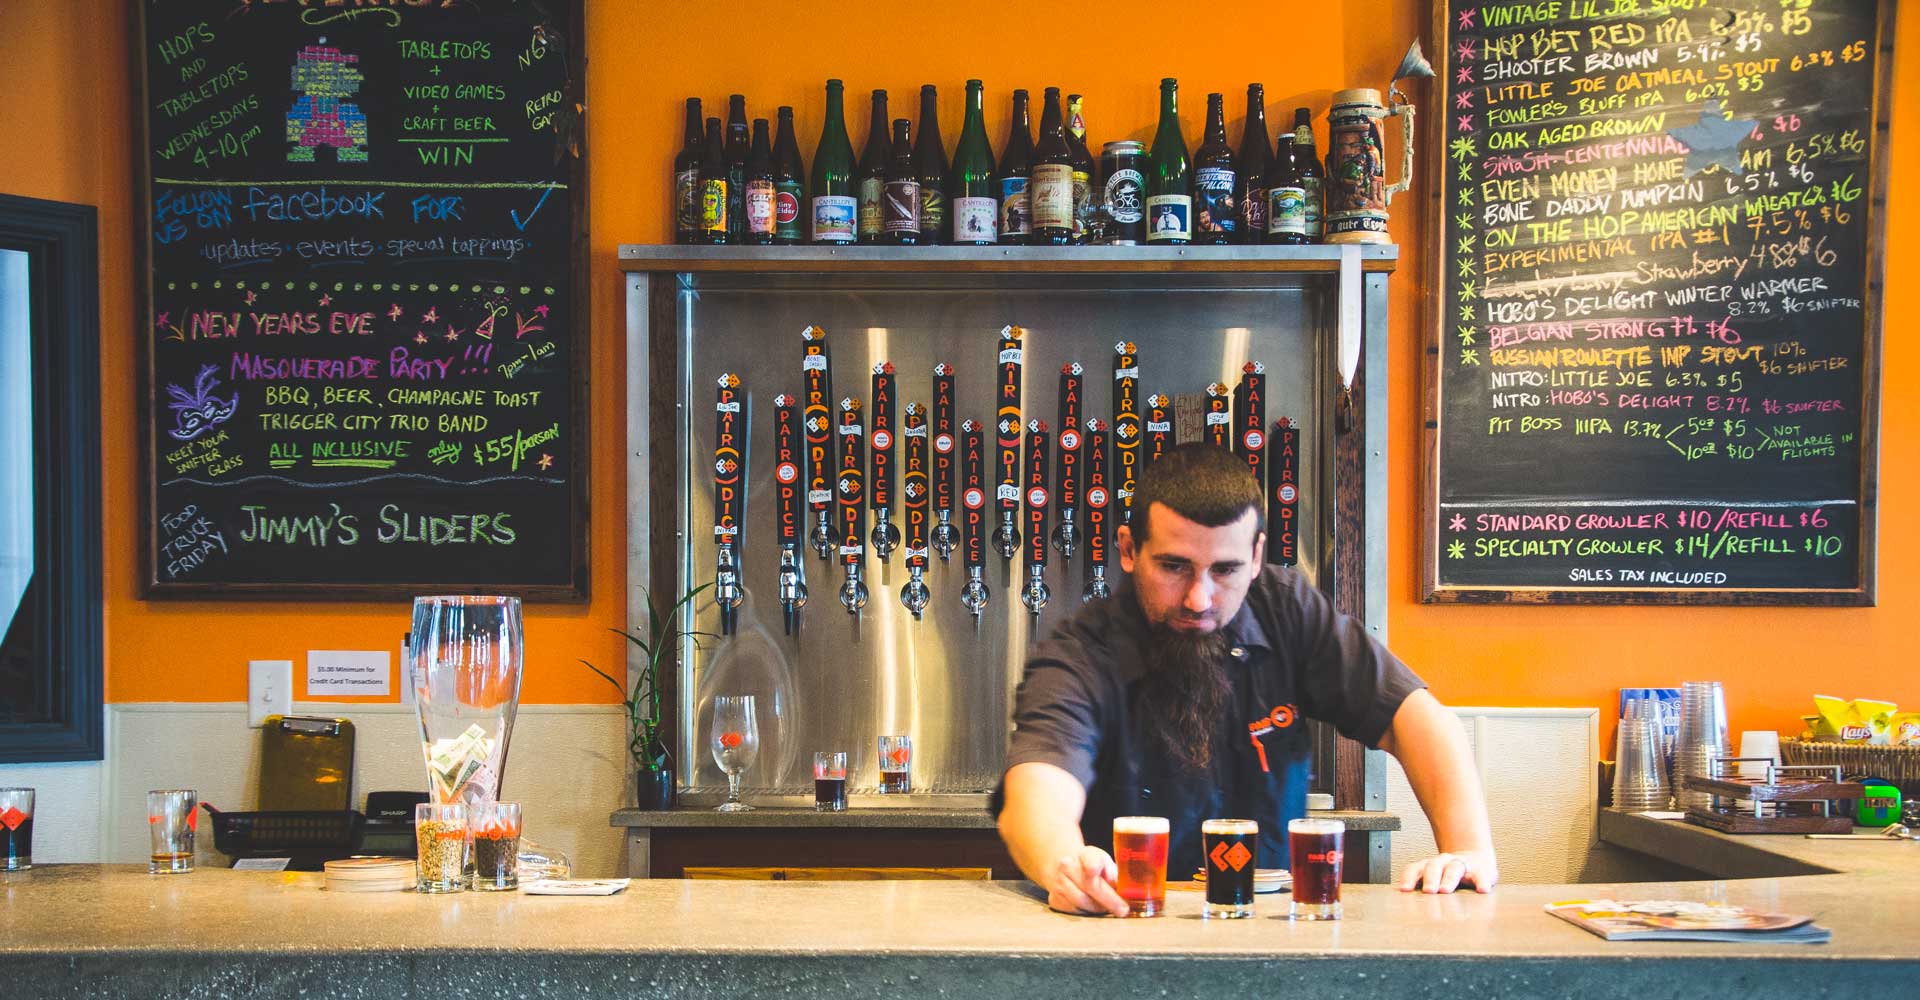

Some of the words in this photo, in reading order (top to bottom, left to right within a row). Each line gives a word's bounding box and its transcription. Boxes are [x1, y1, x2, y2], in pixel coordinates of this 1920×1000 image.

[1481, 1, 1562, 28] VINTAGE
[1569, 0, 1600, 20] LIL
[158, 22, 215, 65] HOPS
[398, 40, 491, 60] TABLETOPS
[1484, 32, 1524, 61] HOP
[1530, 27, 1581, 60] BET
[1588, 21, 1646, 51] RED
[1656, 16, 1694, 44] IPA
[1781, 7, 1812, 36] $5
[179, 58, 206, 81] AND
[1483, 56, 1576, 81] SHOOTER
[1584, 47, 1659, 74] BROWN
[1735, 32, 1762, 53] $5
[1484, 81, 1553, 105] LITTLE
[1566, 76, 1607, 96] JOE
[1615, 66, 1708, 93] OATMEAL
[1714, 58, 1780, 81] STOUT
[1841, 40, 1867, 64] $5
[157, 62, 249, 117] TABLETOPS
[404, 85, 450, 99] VIDEO
[455, 84, 506, 100] GAMES
[525, 90, 562, 119] RETRO
[1486, 100, 1568, 128] FOWLER'S
[1578, 93, 1627, 116] BLUFF
[1633, 89, 1665, 108] IPA
[1737, 74, 1764, 93] $5
[156, 94, 259, 161] WEDNESDAYS
[403, 116, 446, 131] CRAFT
[454, 117, 496, 131] BEER
[1487, 130, 1530, 151] OAK
[1537, 126, 1586, 147] AGED
[1590, 111, 1666, 138] BROWN
[1771, 113, 1801, 134] $6
[418, 145, 473, 167] WIN
[1481, 174, 1541, 203] EVEN
[1550, 164, 1618, 198] MONEY
[1482, 199, 1536, 227] BONE
[1545, 192, 1613, 219] DADDY
[1620, 179, 1704, 211] PUMPKIN
[1725, 170, 1780, 196] 6.5%
[1787, 162, 1815, 185] $6
[1484, 222, 1519, 252] ON
[1526, 217, 1573, 246] THE
[1582, 209, 1640, 243] HOP
[1640, 204, 1740, 234] AMERICAN
[1743, 192, 1802, 219] WHEAT
[1830, 172, 1864, 203] $6
[203, 238, 282, 263] updates
[296, 237, 375, 258] events
[451, 237, 525, 260] tappings
[1484, 235, 1637, 276] EXPERIMENTAL
[1649, 227, 1689, 254] IPA
[1692, 221, 1731, 248] #1
[1745, 210, 1812, 242] 7.5%
[1820, 202, 1851, 226] $6
[1487, 298, 1558, 324] HOBO'S
[1564, 289, 1660, 318] DELIGHT
[1664, 284, 1735, 308] WINTER
[1741, 276, 1829, 303] WARMER
[191, 309, 241, 340] NEW
[249, 312, 320, 336] YEARS
[329, 312, 377, 335] EVE
[1486, 322, 1573, 352] BELGIAN
[1583, 320, 1666, 342] STRONG
[230, 352, 381, 380] MASQUERADE
[390, 346, 455, 380] PARTY
[1488, 348, 1558, 370] RUSSIAN
[1660, 344, 1692, 370] IMP
[1700, 343, 1766, 367] STOUT
[1773, 341, 1809, 358] 10%
[388, 389, 486, 406] CHAMPAGNE
[492, 390, 543, 408] TOAST
[1549, 369, 1610, 388] LITTLE
[1615, 369, 1655, 389] JOE
[1716, 370, 1744, 394] $5
[876, 378, 888, 428] PAIR
[938, 382, 950, 430] PAIR
[1549, 388, 1611, 408] HOBO'S
[1617, 394, 1695, 410] DELIGHT
[259, 413, 338, 431] TRIGGER
[343, 414, 382, 431] CITY
[388, 414, 430, 431] TRIO
[437, 414, 488, 433] BAND
[779, 411, 791, 461] PAIR
[1487, 416, 1514, 436] PIT
[1519, 415, 1563, 435] BOSS
[1622, 418, 1664, 440] 13.7%
[1772, 424, 1808, 437] NOT
[165, 441, 194, 465] KEEP
[197, 429, 230, 451] YOUR
[269, 442, 304, 460] ALL
[312, 440, 413, 459] INCLUSIVE
[427, 440, 463, 465] only
[1767, 433, 1836, 452] AVAILABLE
[1841, 431, 1855, 445] IN
[1782, 445, 1834, 462] FLIGHTS
[175, 447, 222, 475] SNIFTER
[207, 454, 244, 477] GLASS
[968, 437, 980, 486] PAIR
[1033, 436, 1044, 484] PAIR
[874, 454, 887, 504] DICE
[937, 457, 949, 508] DICE
[160, 504, 198, 537] FOOD
[240, 503, 360, 547] JIMMY'S
[377, 503, 517, 546] SLIDERS
[782, 487, 794, 537] DICE
[1475, 513, 1573, 533] STANDARD
[1575, 511, 1670, 531] GROWLER
[1799, 508, 1829, 529] $6
[161, 516, 215, 560] TRUCK
[968, 512, 980, 562] DICE
[1032, 511, 1043, 562] DICE
[1473, 537, 1575, 558] SPECIALTY
[1576, 536, 1664, 557] GROWLER
[1804, 534, 1843, 557] $10
[167, 531, 229, 579] FRIDAY
[1568, 566, 1615, 583] SALES
[1619, 567, 1646, 583] TAX
[1649, 570, 1728, 586] INCLUDED
